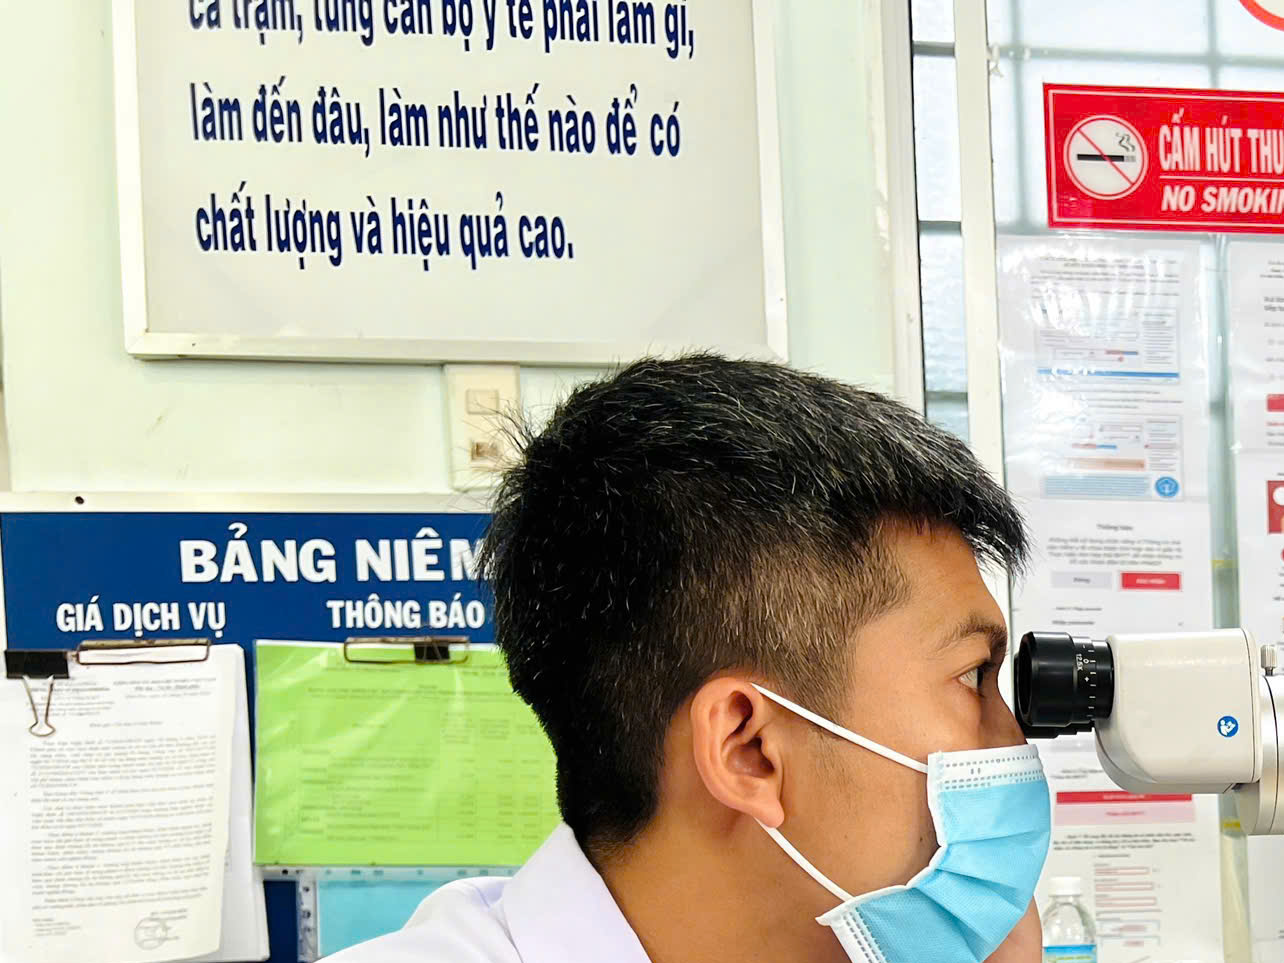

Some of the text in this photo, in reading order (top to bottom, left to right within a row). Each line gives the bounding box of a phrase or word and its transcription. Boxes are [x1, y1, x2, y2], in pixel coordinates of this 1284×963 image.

[483, 0, 496, 51] y
[190, 75, 680, 157] làm đến đâu, làm như thế nào để có
[1158, 107, 1200, 171] CẤM
[1205, 114, 1243, 173] HÚT
[195, 181, 574, 271] chất lượng và hiệu quả cao.
[1161, 185, 1195, 212] NO
[179, 522, 337, 583] BẢNG
[56, 595, 227, 639] GIÁ DỊCH VỤ
[326, 593, 486, 629] THÔNG BÁO
